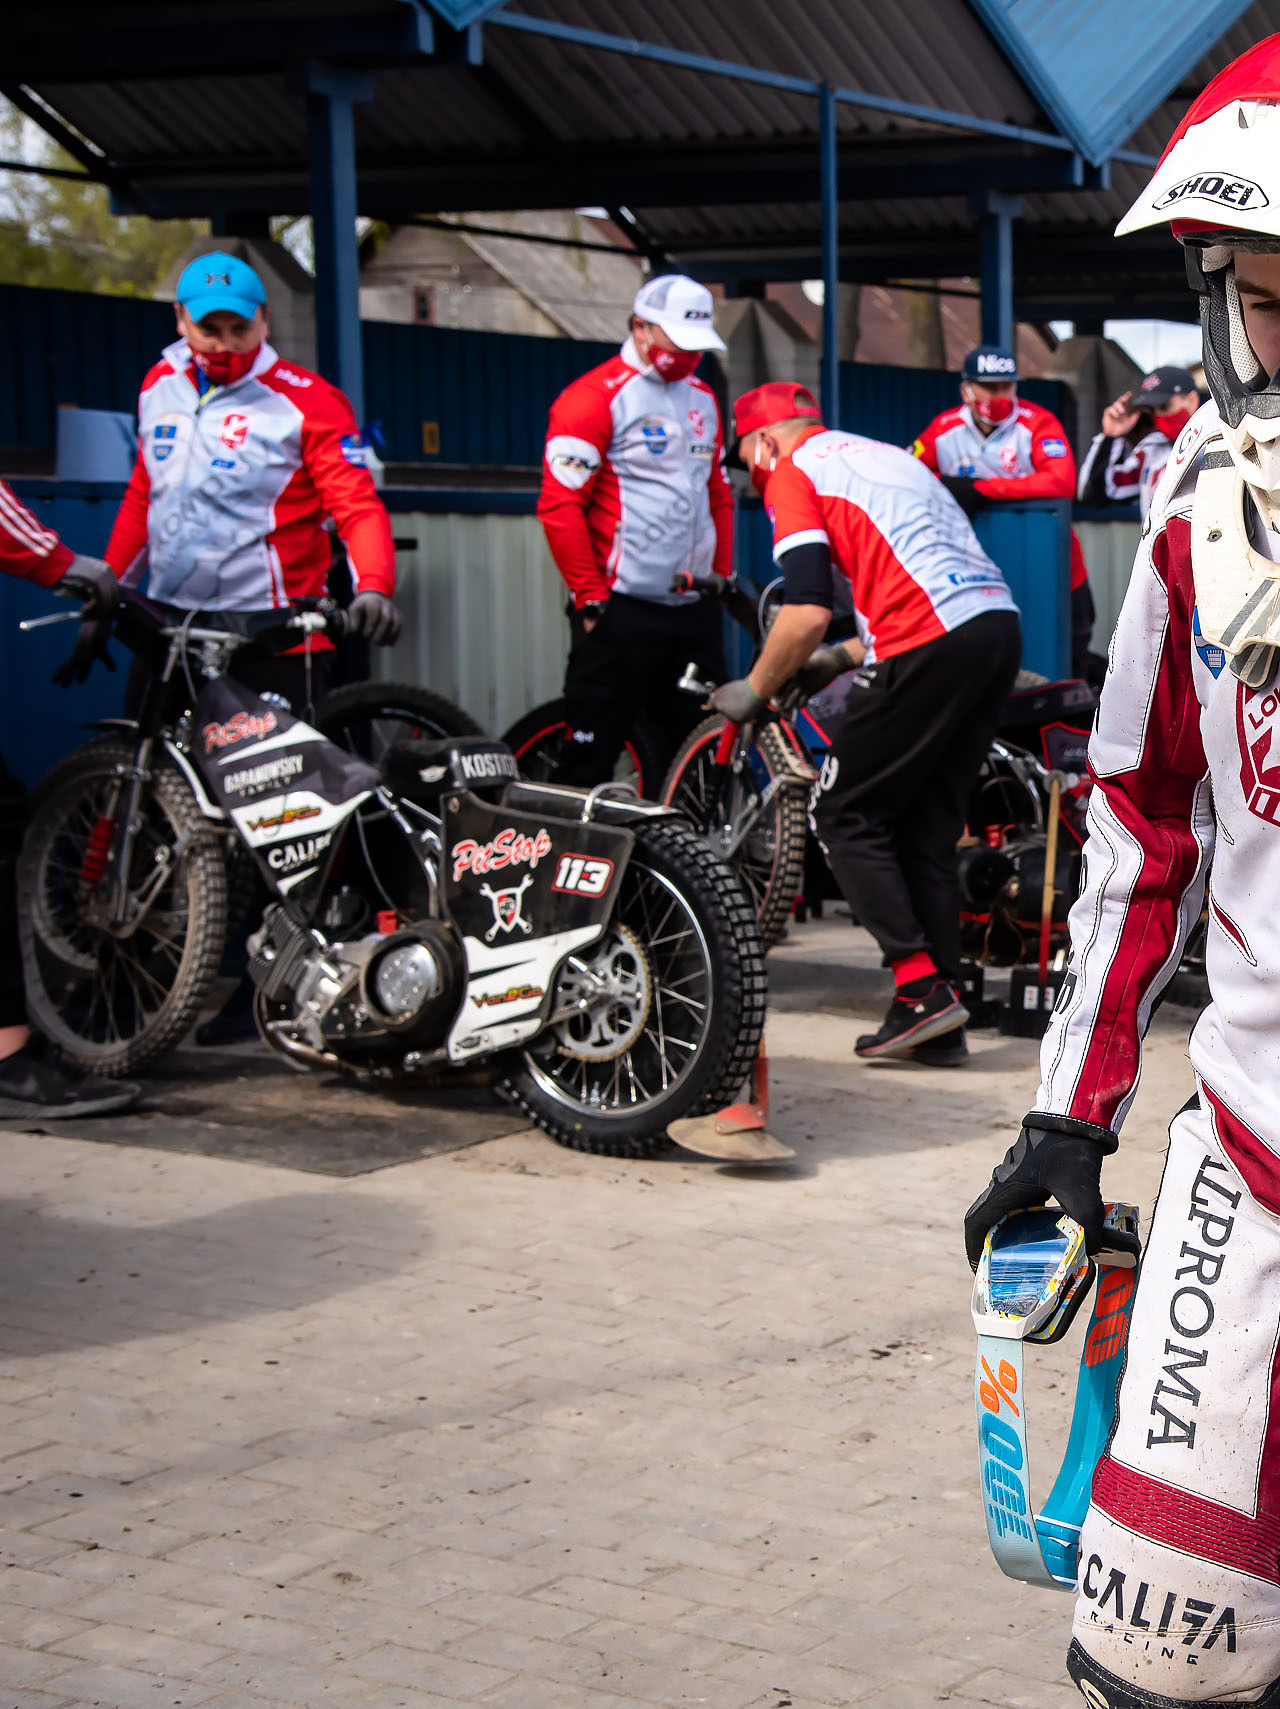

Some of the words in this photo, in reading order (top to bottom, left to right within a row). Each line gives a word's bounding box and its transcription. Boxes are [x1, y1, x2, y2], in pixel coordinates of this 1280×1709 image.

[1163, 176, 1254, 206] SHOEI
[555, 857, 611, 894] 113
[1083, 1553, 1239, 1655] CALIFA
[1089, 1610, 1200, 1666] RACING
